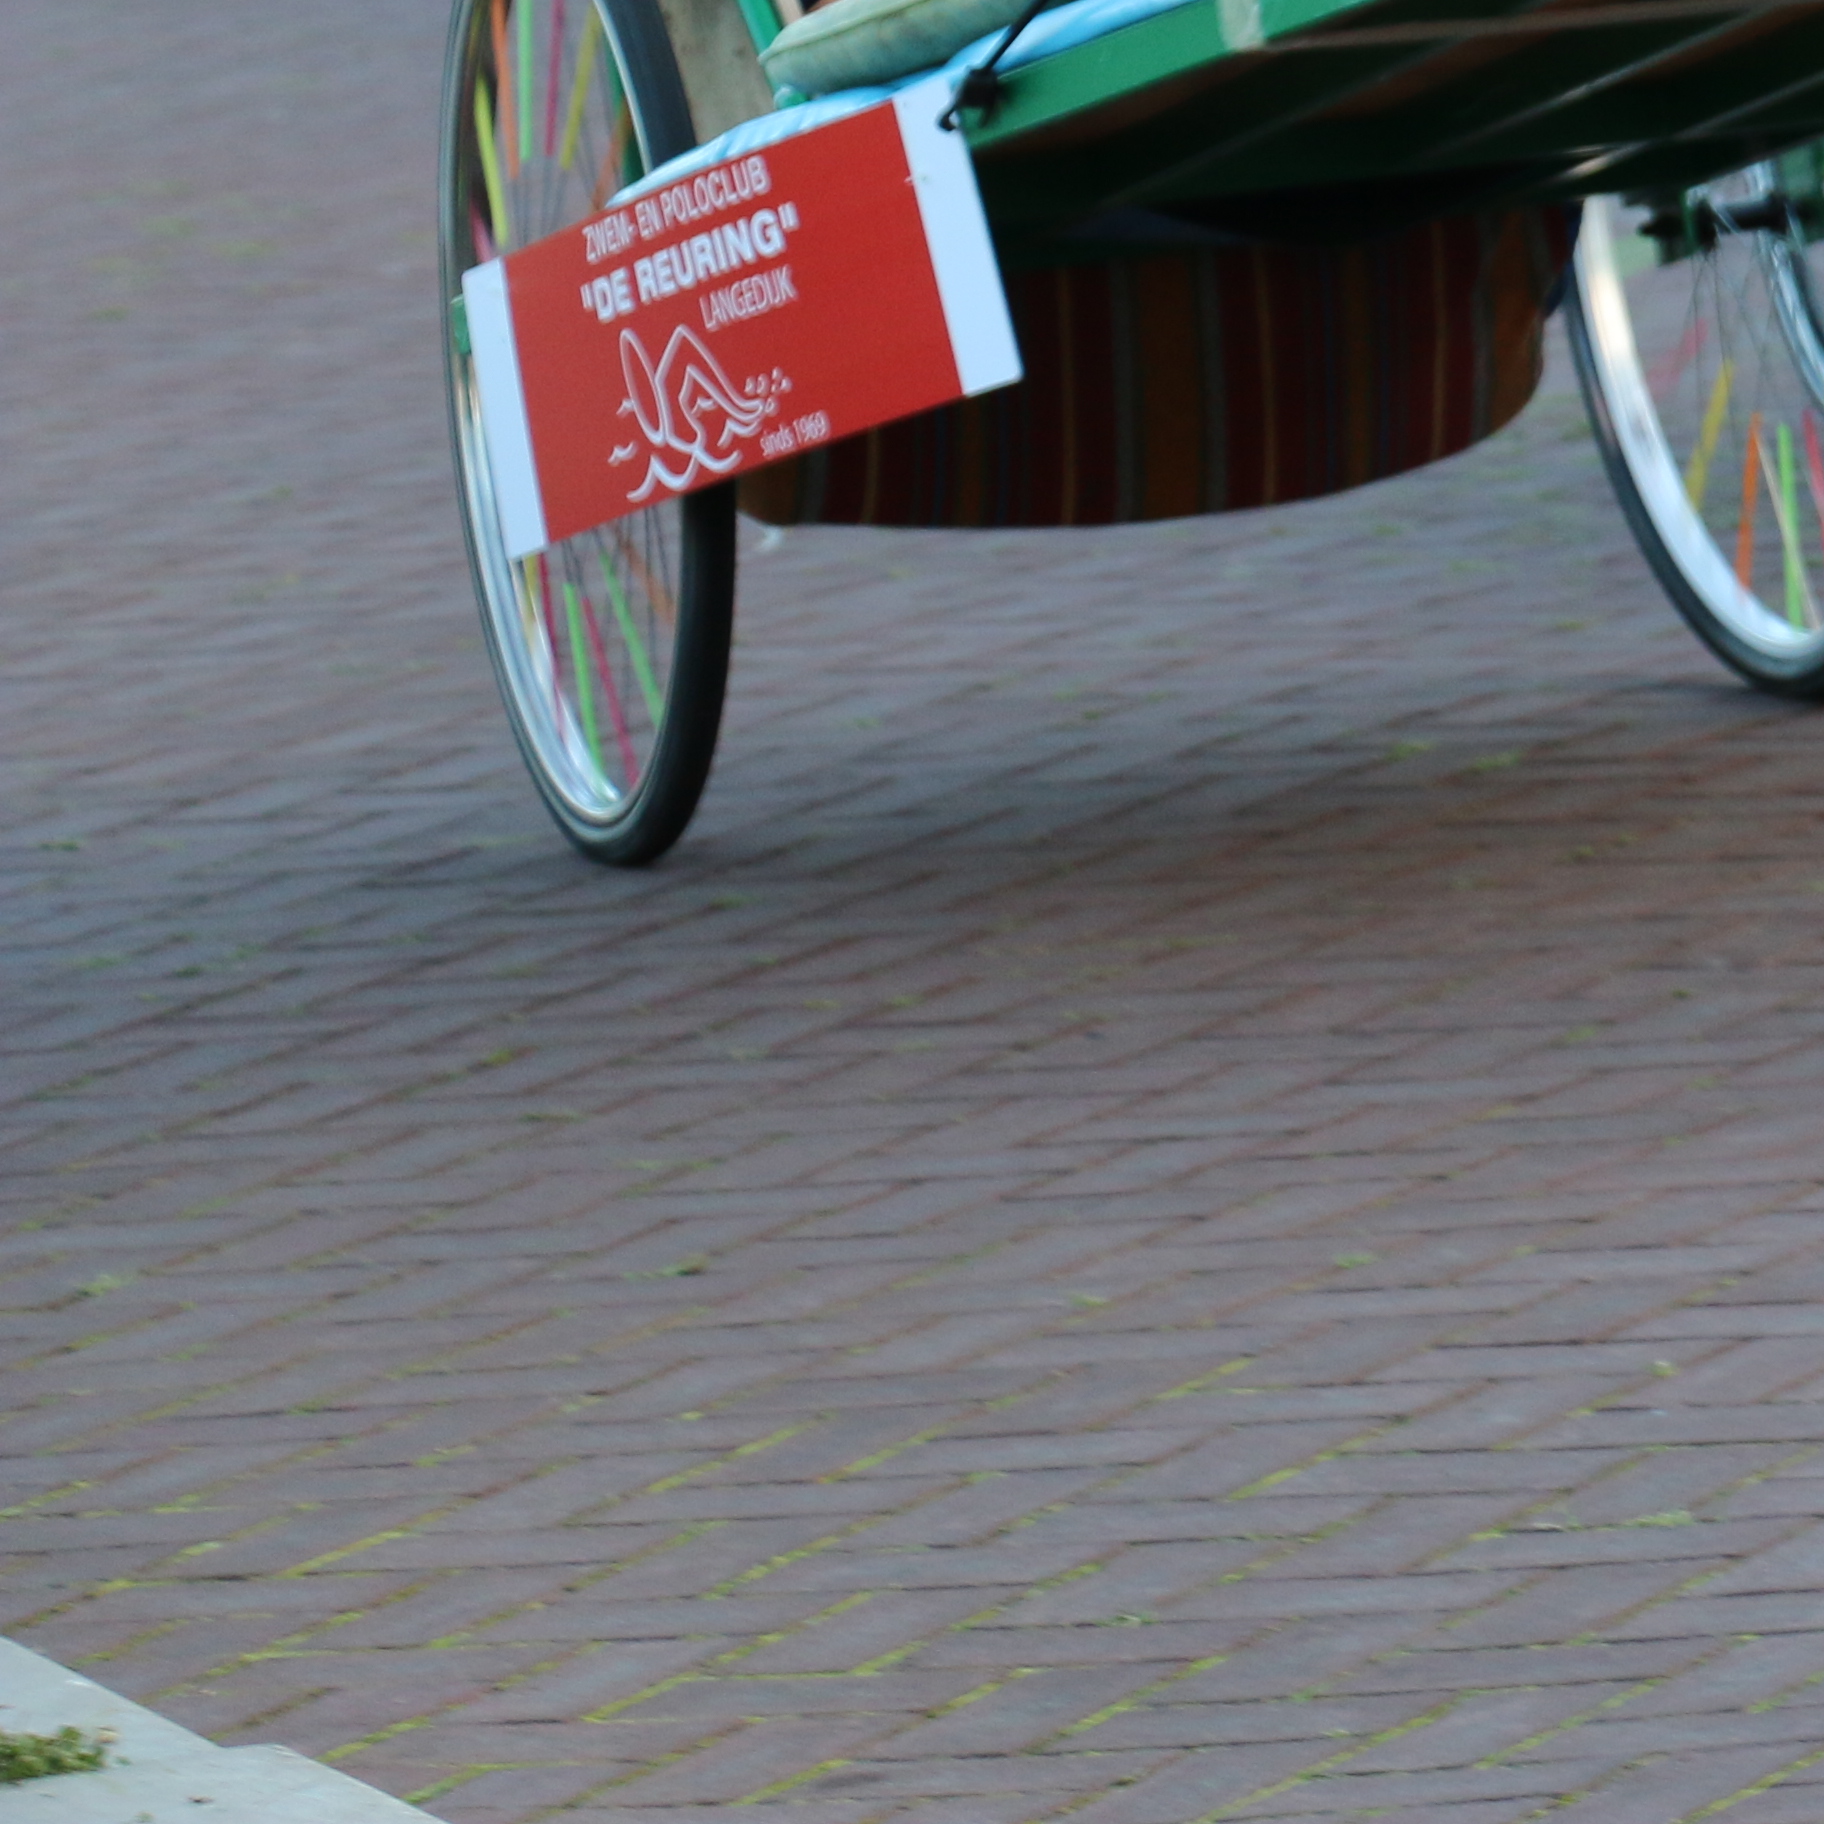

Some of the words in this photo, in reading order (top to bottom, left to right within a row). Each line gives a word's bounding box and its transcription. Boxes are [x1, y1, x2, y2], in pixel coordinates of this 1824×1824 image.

[582, 211, 636, 264] ZWEM-
[634, 190, 665, 240] EN
[659, 154, 772, 227] POLOCLUB
[580, 266, 636, 323] "DE
[633, 201, 799, 305] REURING"
[699, 264, 797, 332] LANGEDIJK
[760, 424, 794, 458] sinds
[793, 410, 829, 443] 1969
